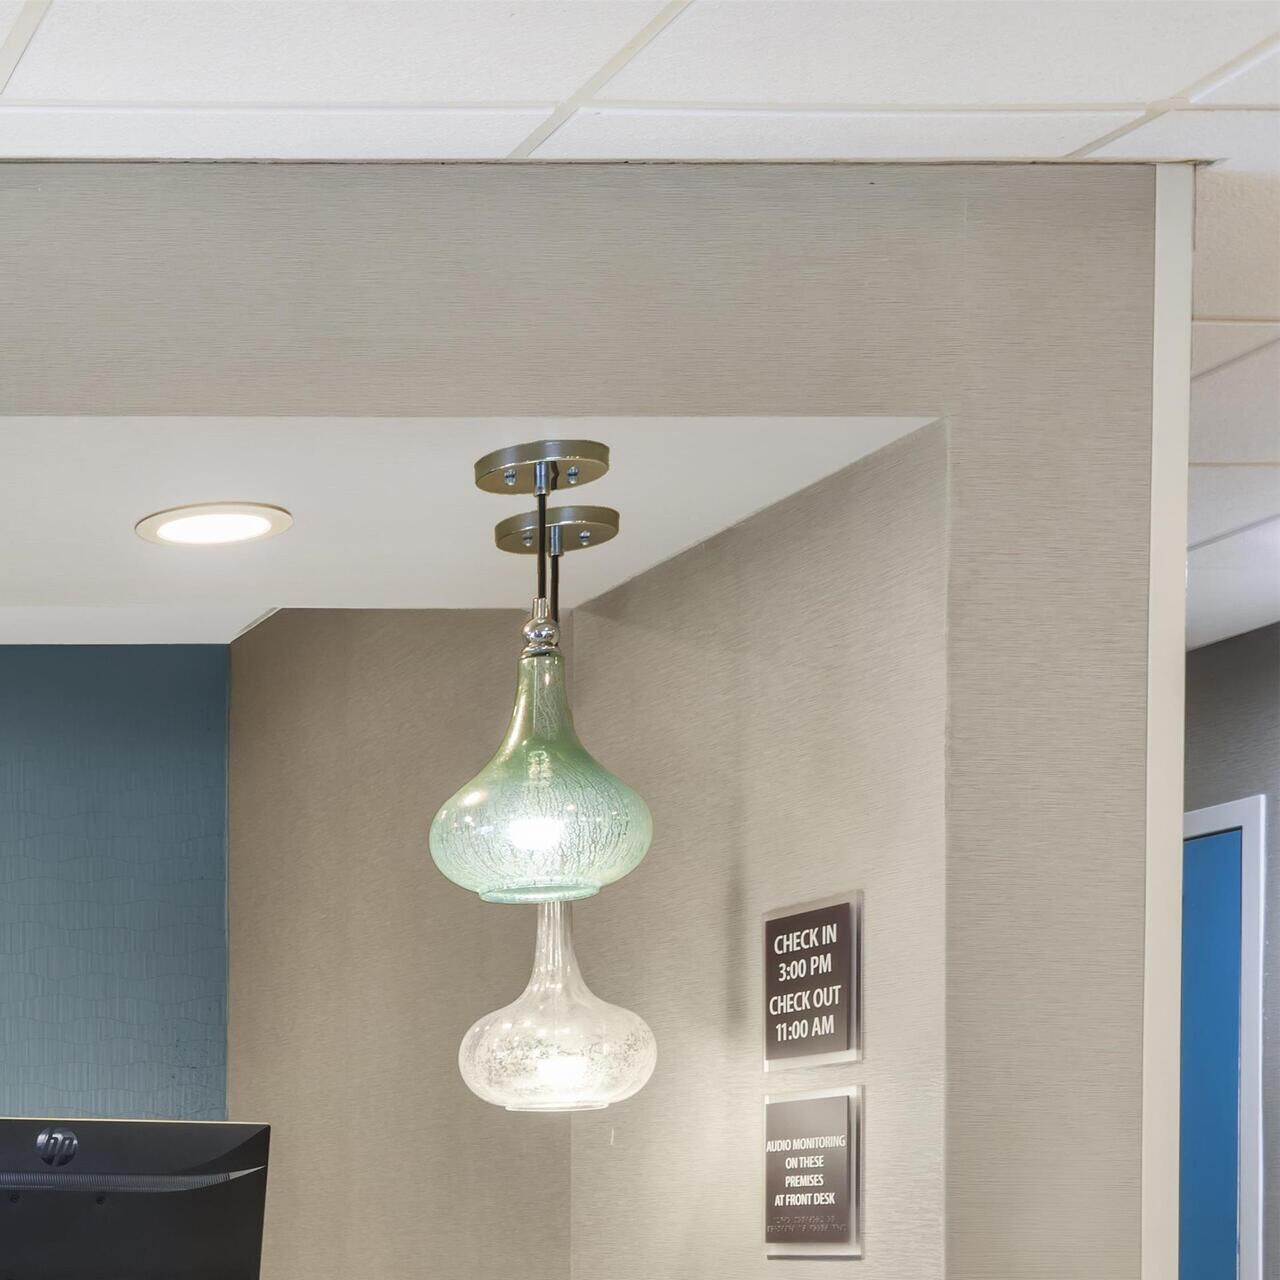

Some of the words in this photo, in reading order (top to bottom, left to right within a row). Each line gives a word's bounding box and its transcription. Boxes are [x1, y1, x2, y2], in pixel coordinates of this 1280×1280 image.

[774, 927, 819, 955] CHECK
[822, 923, 837, 945] IN
[778, 958, 807, 981] 3:00
[810, 953, 832, 976] PM
[769, 990, 811, 1015] CHECK
[813, 985, 842, 1008] OUT
[776, 1019, 808, 1042] 11:00
[811, 1014, 834, 1037] AM
[766, 1139, 792, 1153] AUDIO
[792, 1135, 846, 1151] MONITORING
[785, 1157, 798, 1169] ON
[799, 1155, 824, 1169] THESE
[785, 1174, 824, 1188] PREMISES
[774, 1194, 785, 1207] AT
[785, 1193, 812, 1206] FRONT
[813, 1192, 835, 1205] DESK
